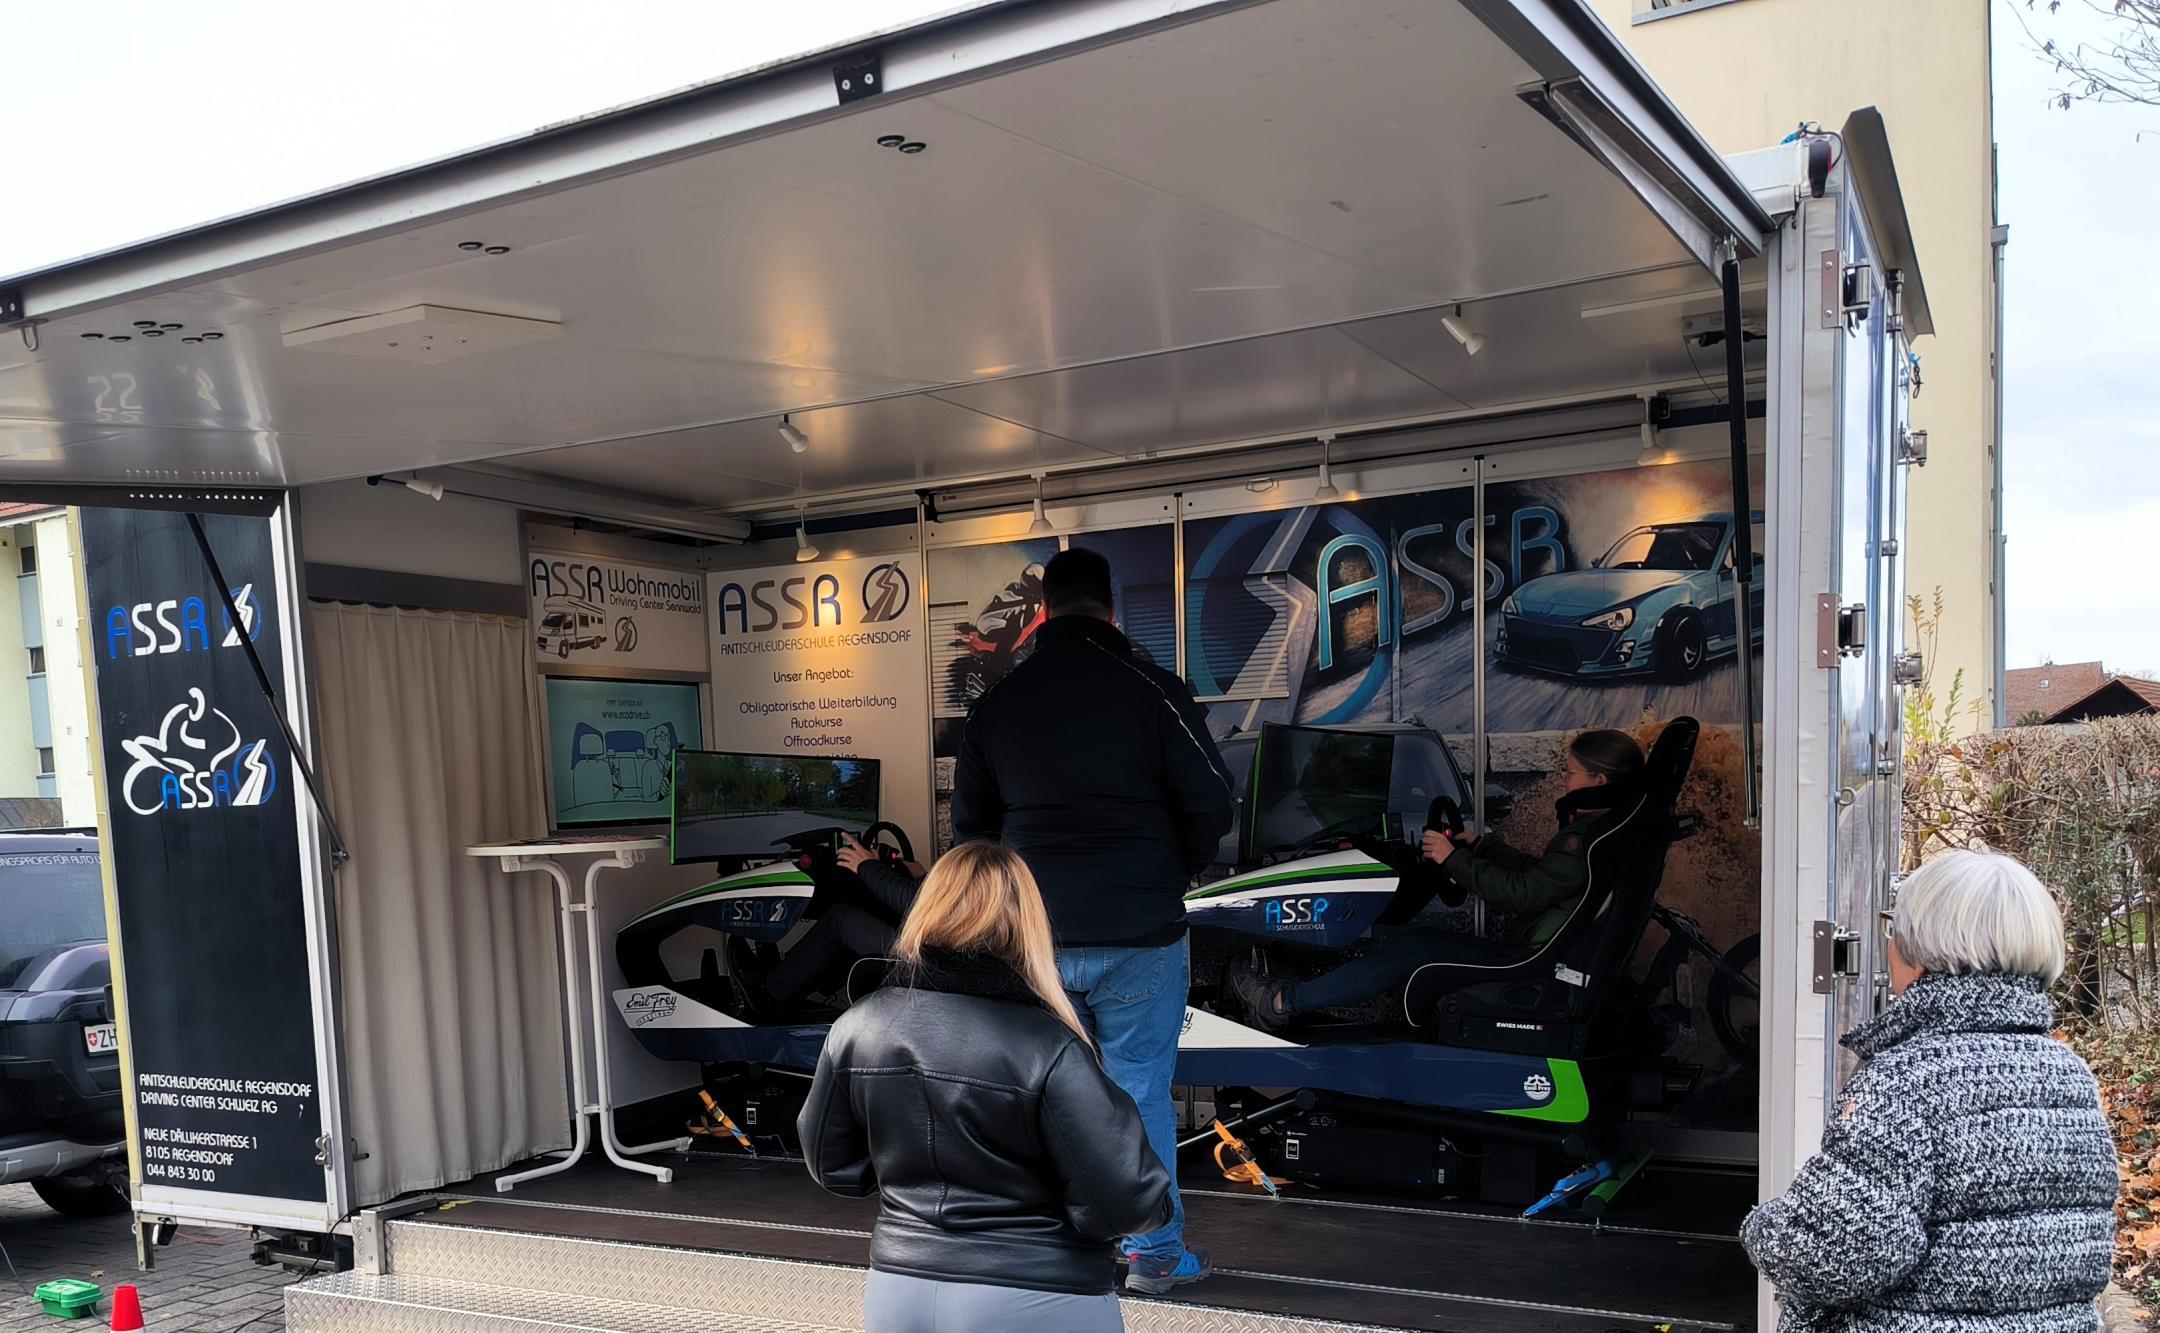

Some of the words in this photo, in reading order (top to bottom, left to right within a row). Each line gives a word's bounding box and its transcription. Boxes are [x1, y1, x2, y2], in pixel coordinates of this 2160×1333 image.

[531, 559, 604, 603] ASSR
[607, 568, 701, 601] Wohnmobil
[1318, 506, 1564, 670] ASSR
[610, 594, 637, 611] Driving
[639, 597, 664, 611] Center
[665, 600, 702, 614] Sennwald
[718, 574, 842, 634] ASSR
[107, 596, 209, 660] ASSR
[721, 635, 835, 655] ANTISCHLEUDERSCHULE
[838, 630, 912, 646] REGENSDORF
[773, 669, 802, 683] Unser
[805, 668, 854, 683] Angebot:
[739, 698, 816, 716] Obligatorische
[819, 695, 897, 710] Weiterbildung
[791, 717, 843, 729] Autokurse
[784, 734, 852, 748] Offroadkurse
[161, 769, 232, 810] ASSR
[98, 1028, 118, 1048] ZH
[140, 1073, 243, 1093] ANTISCHLEUDERSCHULE
[245, 1080, 312, 1097] REGENSDORF
[141, 1092, 179, 1107] DRIVING
[181, 1095, 216, 1109] CENTER
[218, 1097, 260, 1113] SCHWEIZ
[262, 1100, 278, 1114] AG
[144, 1128, 168, 1142] NEUE
[170, 1128, 250, 1149] DÄLLIKERSTRASSE
[252, 1136, 257, 1149] 1
[146, 1146, 170, 1160] 8105
[172, 1148, 234, 1166] REGENSDORF
[147, 1164, 165, 1176] 044
[168, 1165, 185, 1179] 843
[188, 1167, 200, 1180] 30
[202, 1169, 215, 1182] 00
